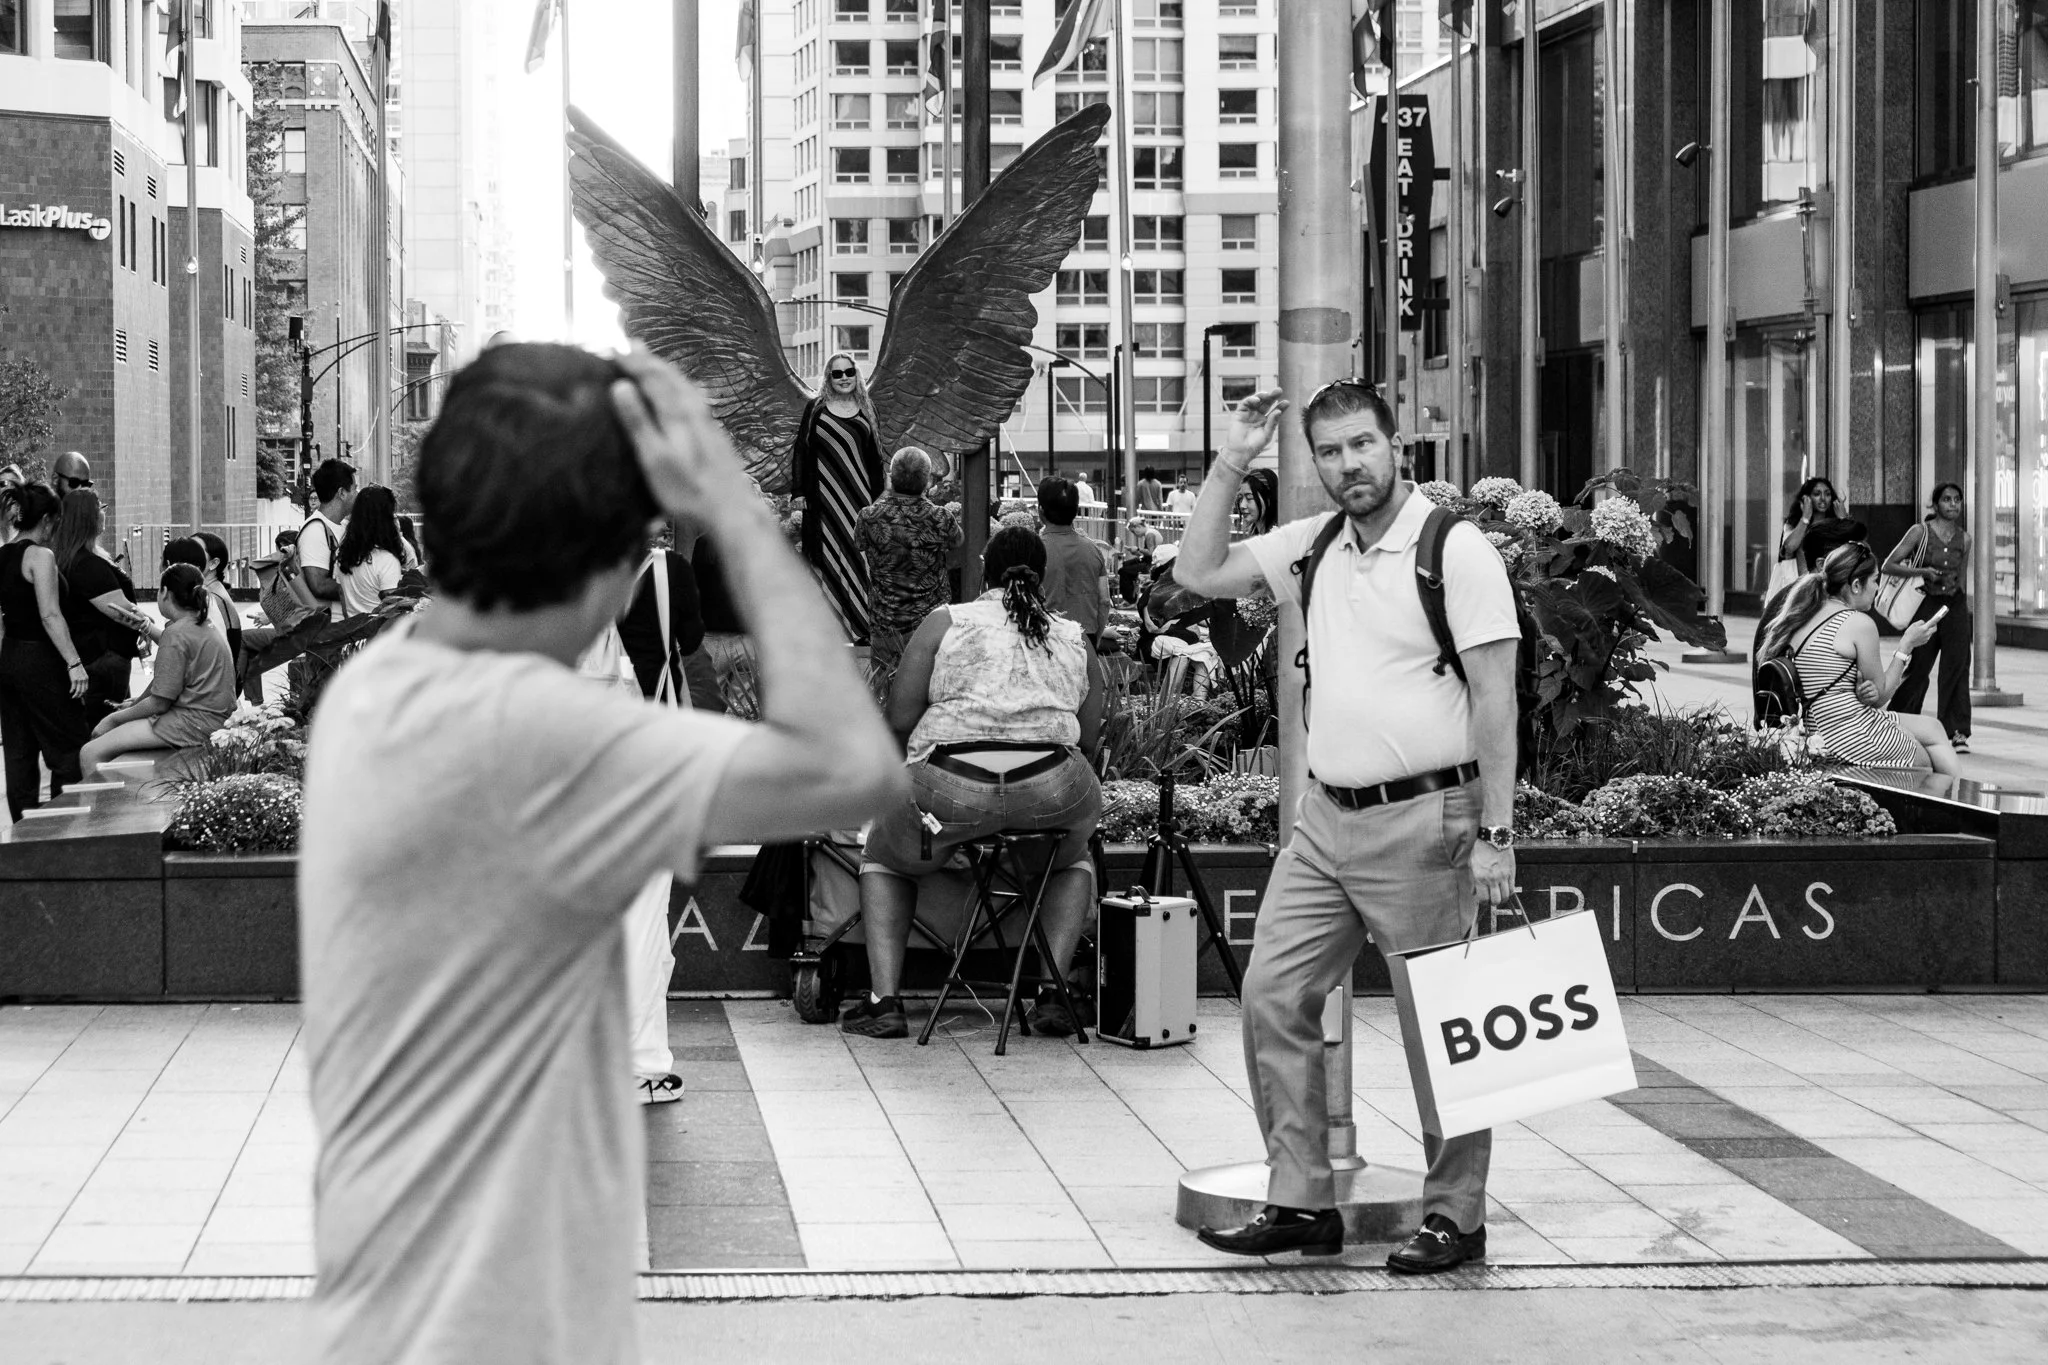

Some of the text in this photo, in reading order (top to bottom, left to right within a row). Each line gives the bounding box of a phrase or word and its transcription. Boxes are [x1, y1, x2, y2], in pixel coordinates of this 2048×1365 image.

[0, 203, 93, 229] LasikPlus
[1397, 137, 1414, 317] EAT DRINK
[1440, 984, 1599, 1065] BOSS
